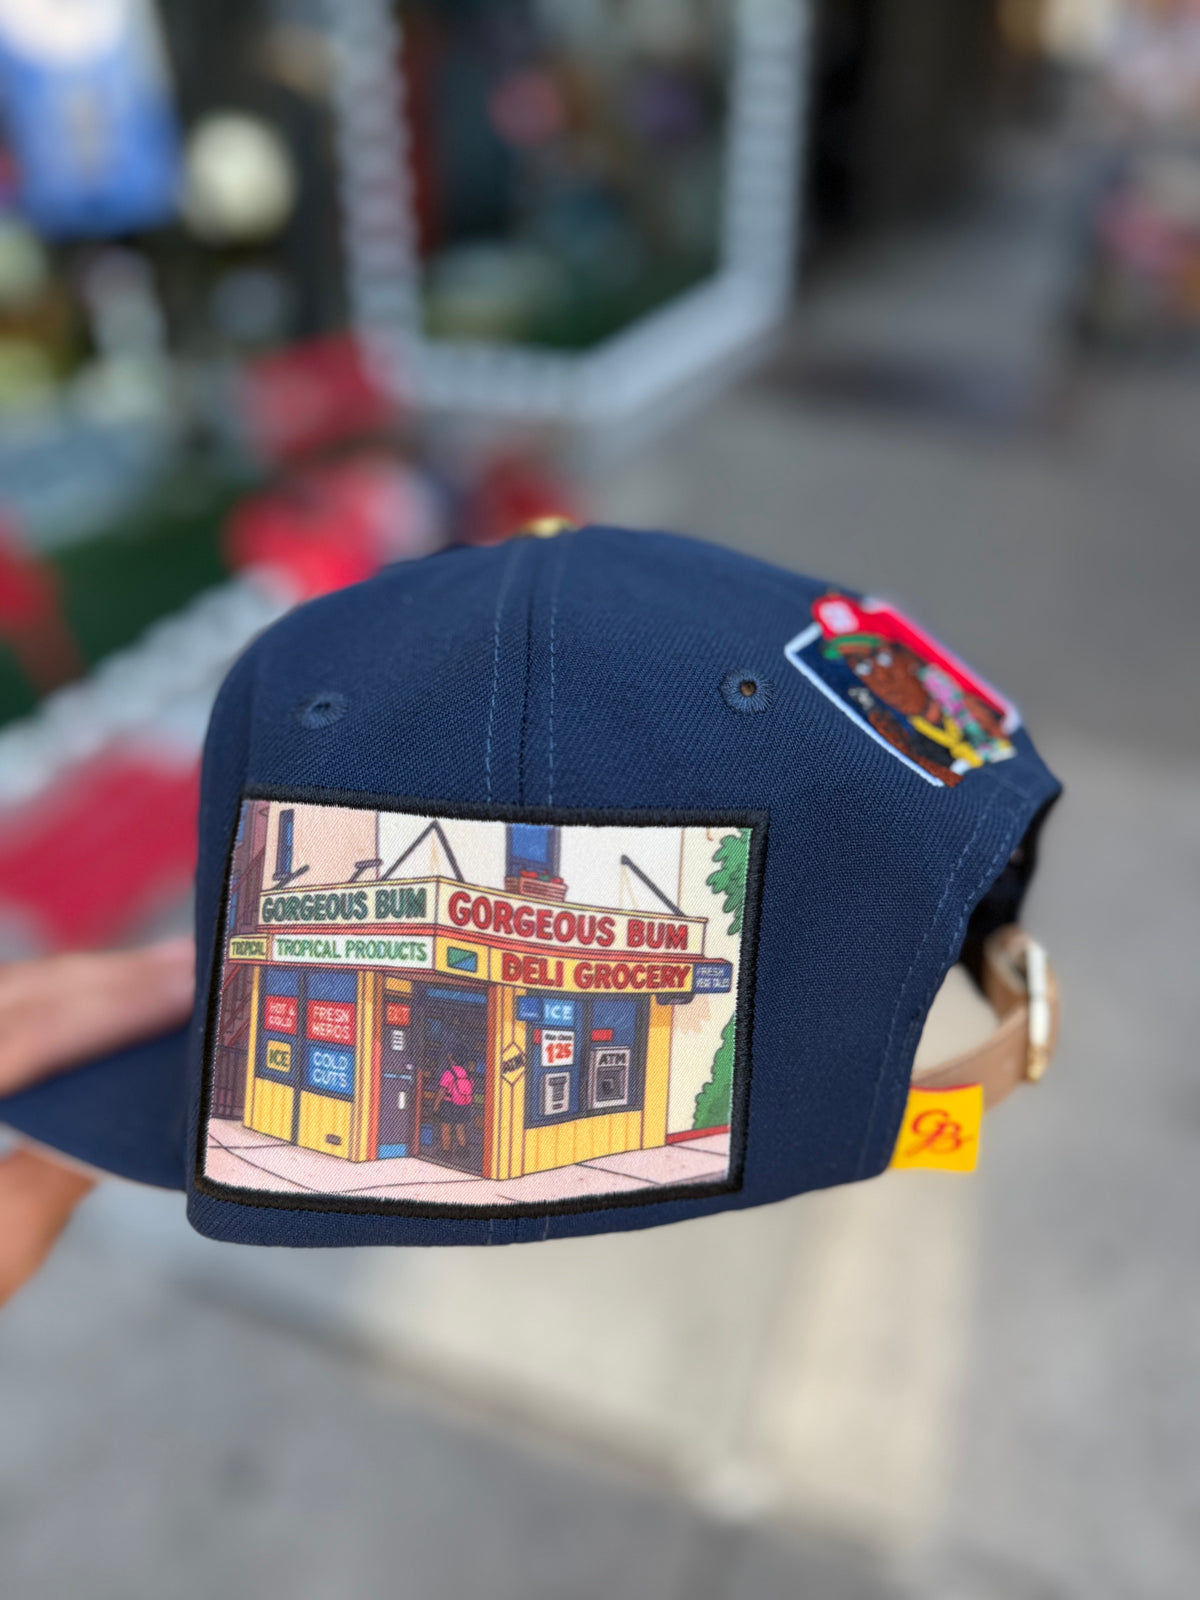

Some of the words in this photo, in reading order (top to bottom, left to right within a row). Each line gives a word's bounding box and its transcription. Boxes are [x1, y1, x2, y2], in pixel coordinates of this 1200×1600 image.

[262, 891, 369, 923] GORGEOUS
[375, 887, 428, 920] BUM
[448, 890, 616, 947] GORGEOUS
[626, 918, 689, 950] BUM
[275, 938, 342, 959] TROPICAL
[344, 939, 429, 962] PRODUCTS
[501, 952, 564, 988] DELI
[573, 961, 692, 993] GROCERY
[545, 1003, 572, 1020] ICE
[268, 1048, 290, 1068] ICE
[312, 1051, 349, 1072] COLD
[600, 1053, 626, 1066] ATM
[312, 1068, 348, 1089] CUTS
